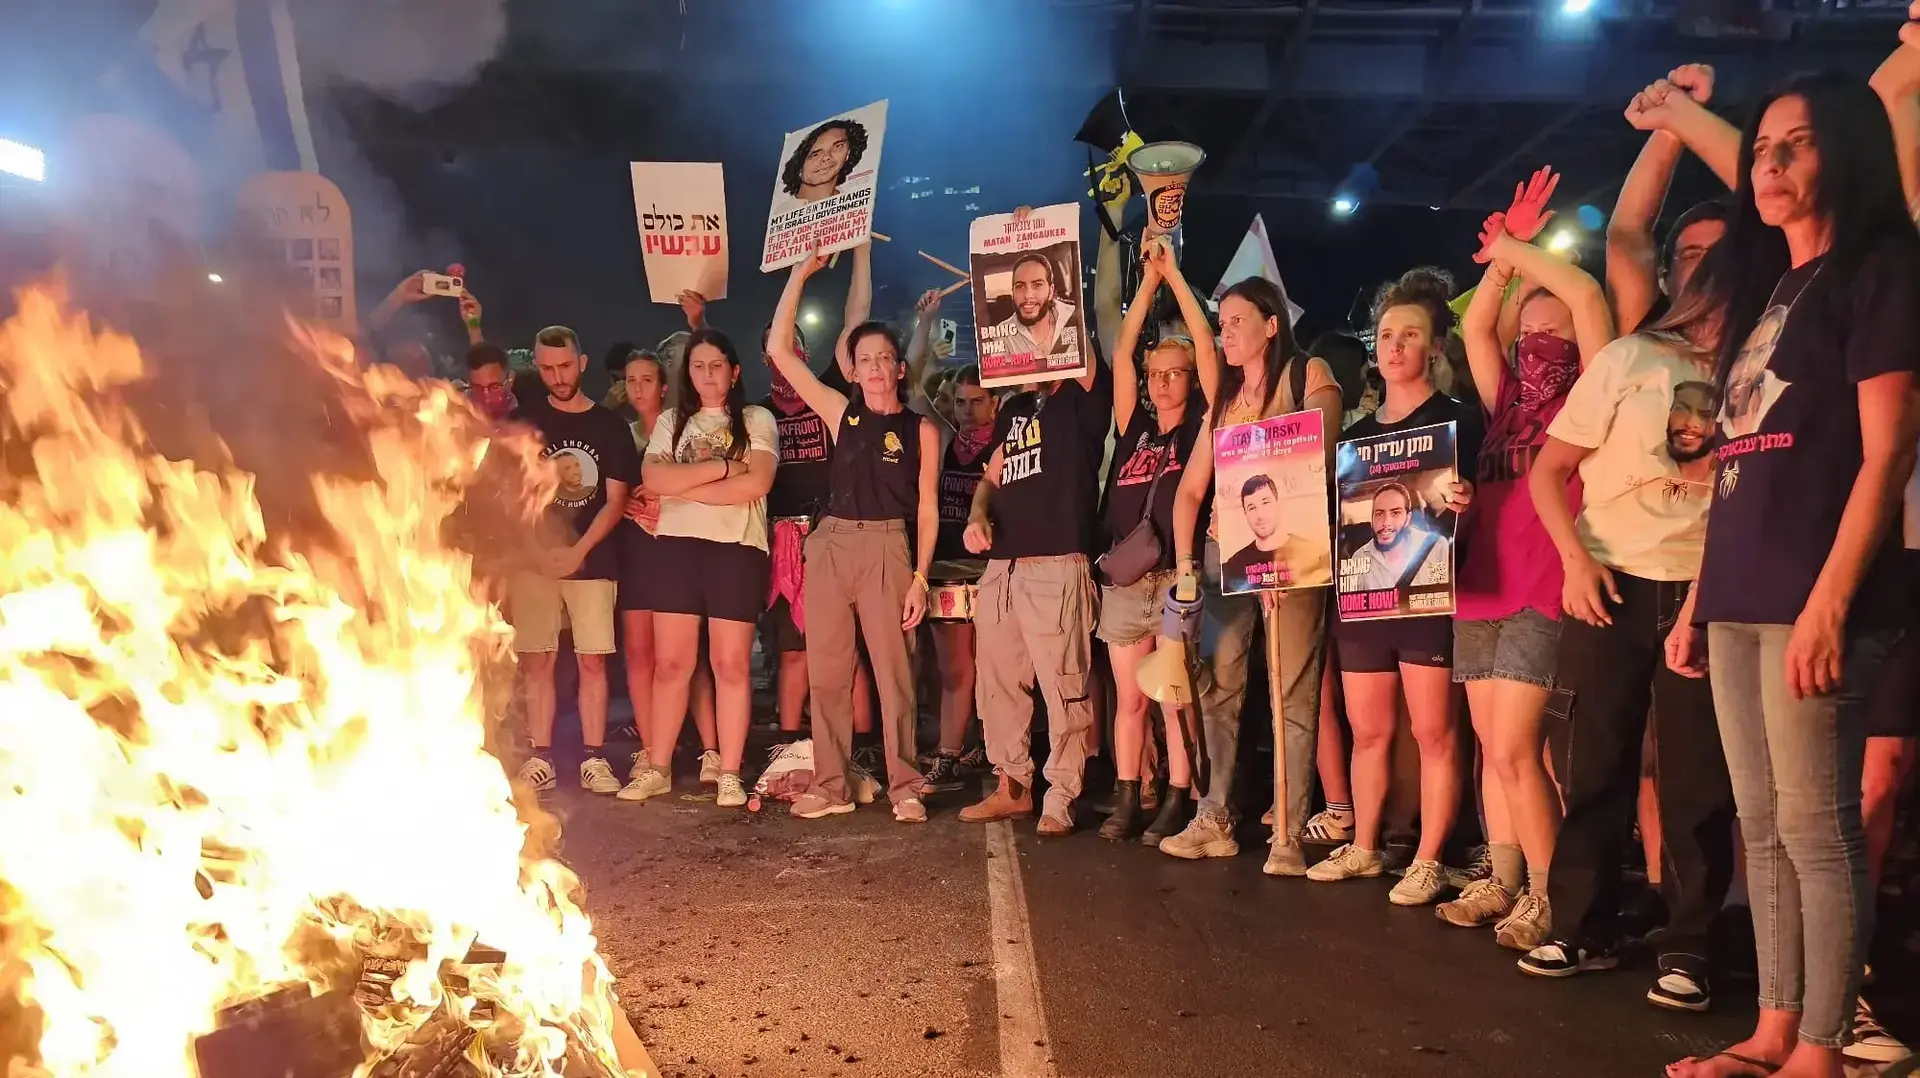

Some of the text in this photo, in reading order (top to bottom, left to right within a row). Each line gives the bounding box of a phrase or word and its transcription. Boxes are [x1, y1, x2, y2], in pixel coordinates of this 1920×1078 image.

[643, 203, 720, 231] את כולם
[771, 215, 784, 226] MY
[785, 207, 806, 222] LIFE
[820, 197, 838, 211] THE
[839, 188, 872, 204] HANDS
[785, 214, 815, 230] ISRAELI
[815, 197, 870, 220] GOVERNMENT
[768, 207, 868, 244] IF THEY DON'T SIGN A DEAL
[768, 216, 868, 254] THEY ARE SIGNING MY
[645, 234, 721, 256] עכשיו
[765, 225, 867, 264] DEATH WARRANT!
[983, 228, 1066, 248] MATAN ZANGAUKER
[980, 323, 1019, 340] BRING
[982, 340, 1006, 355] HIM
[982, 354, 1007, 369] HOME
[778, 418, 820, 436] KFRONT
[1220, 450, 1236, 458] was
[1273, 441, 1282, 449] in
[1283, 433, 1319, 447] captivity
[1232, 431, 1252, 447] ITAY
[1357, 435, 1433, 463] מתן עדיין חי
[1759, 432, 1795, 452] מתן
[562, 439, 600, 462] SHOHAM
[1340, 557, 1371, 576] BRING
[1247, 574, 1262, 585] the
[1261, 571, 1279, 583] last
[1340, 574, 1358, 593] HIM
[1340, 592, 1367, 612] HOME
[1369, 587, 1400, 610] NOW!
